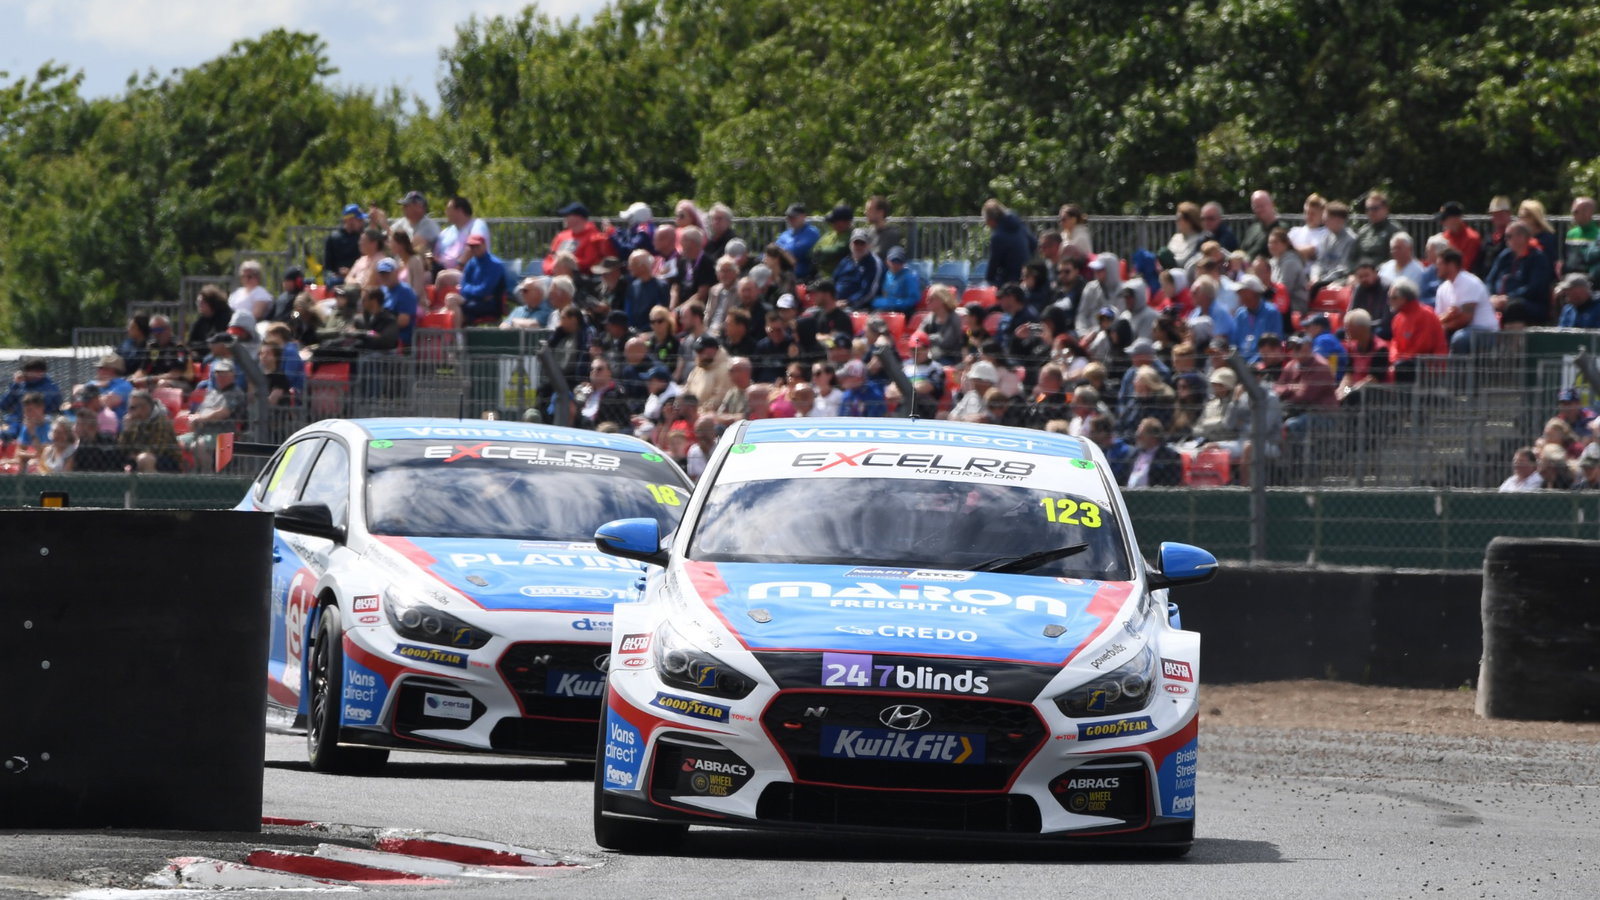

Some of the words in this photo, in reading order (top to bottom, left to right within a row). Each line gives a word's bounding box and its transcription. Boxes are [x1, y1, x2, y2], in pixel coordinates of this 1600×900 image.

[424, 442, 621, 467] EXCELR8
[791, 448, 1036, 476] EXCELR8
[527, 459, 620, 472] MOTORSPORT
[915, 468, 1028, 482] MOTORSPORT
[646, 483, 681, 506] 18
[1040, 497, 1102, 528] 123
[830, 600, 942, 611] FREIGHT
[950, 605, 988, 616] UK
[877, 625, 978, 642] CREDO
[348, 670, 375, 687] Vans
[1164, 667, 1190, 678] GLYM
[344, 685, 375, 702] direct
[442, 700, 470, 709] certas
[658, 696, 723, 718] GOODYEAR
[611, 722, 635, 745] Vans
[1085, 719, 1148, 736] GOODYEAR
[606, 742, 635, 763] direct
[694, 759, 747, 776] ABRACS
[710, 774, 733, 787] WHEEL
[1067, 777, 1119, 789] ABRACS
[710, 785, 727, 796] GODS
[1088, 791, 1112, 801] WHEEL
[1088, 801, 1106, 811] GODS
